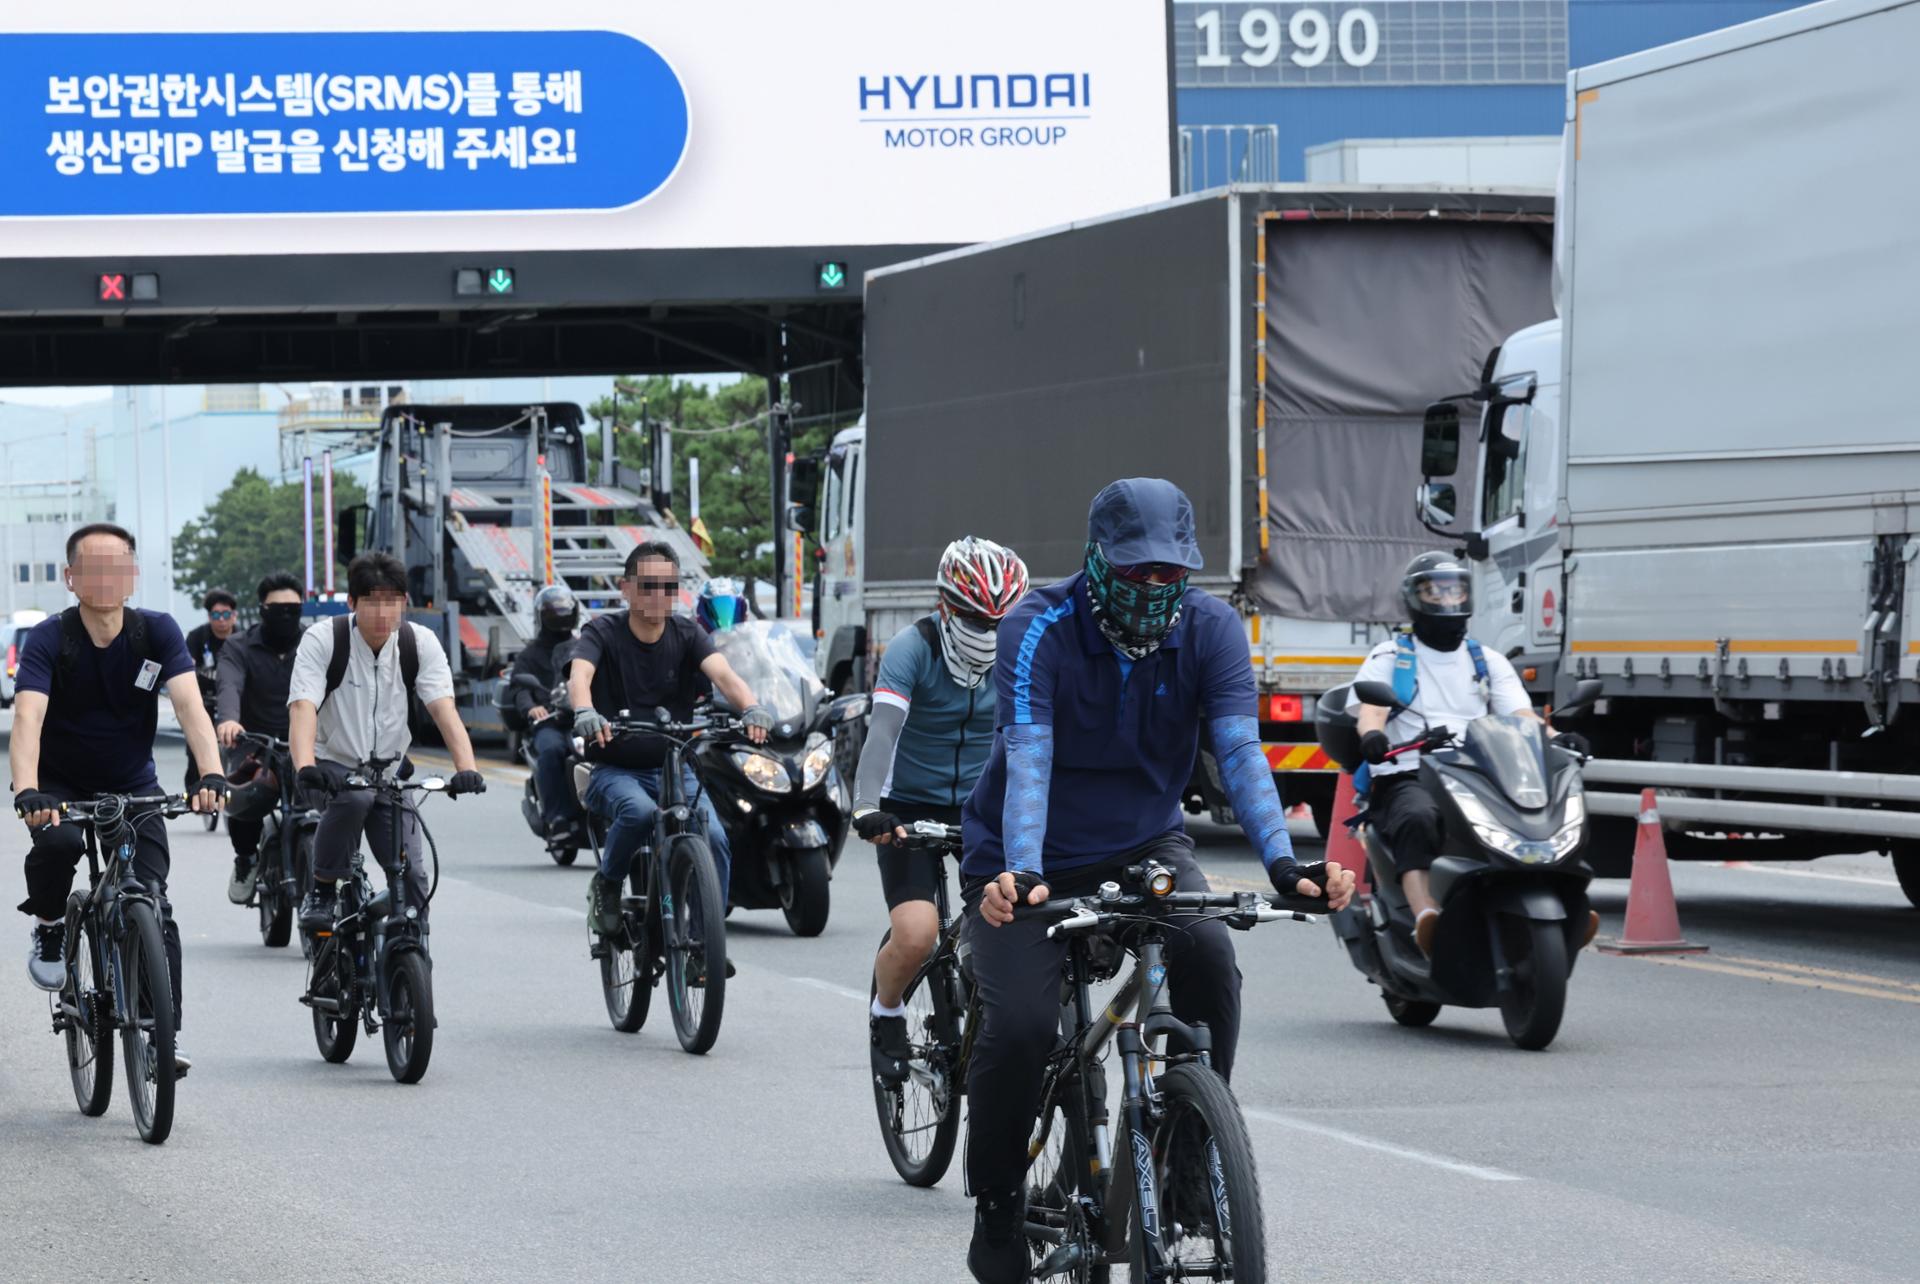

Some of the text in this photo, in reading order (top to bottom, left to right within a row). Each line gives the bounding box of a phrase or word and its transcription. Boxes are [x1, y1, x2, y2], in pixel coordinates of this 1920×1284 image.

[1196, 9, 1378, 67] 1990
[45, 70, 583, 118] 보안권한시스템(SRMS)를 통해
[858, 72, 1091, 112] HYUNDAI
[46, 126, 577, 176] 생산망IP 발급을 신청해 주세요!
[884, 126, 1067, 148] MOTOR GROUP
